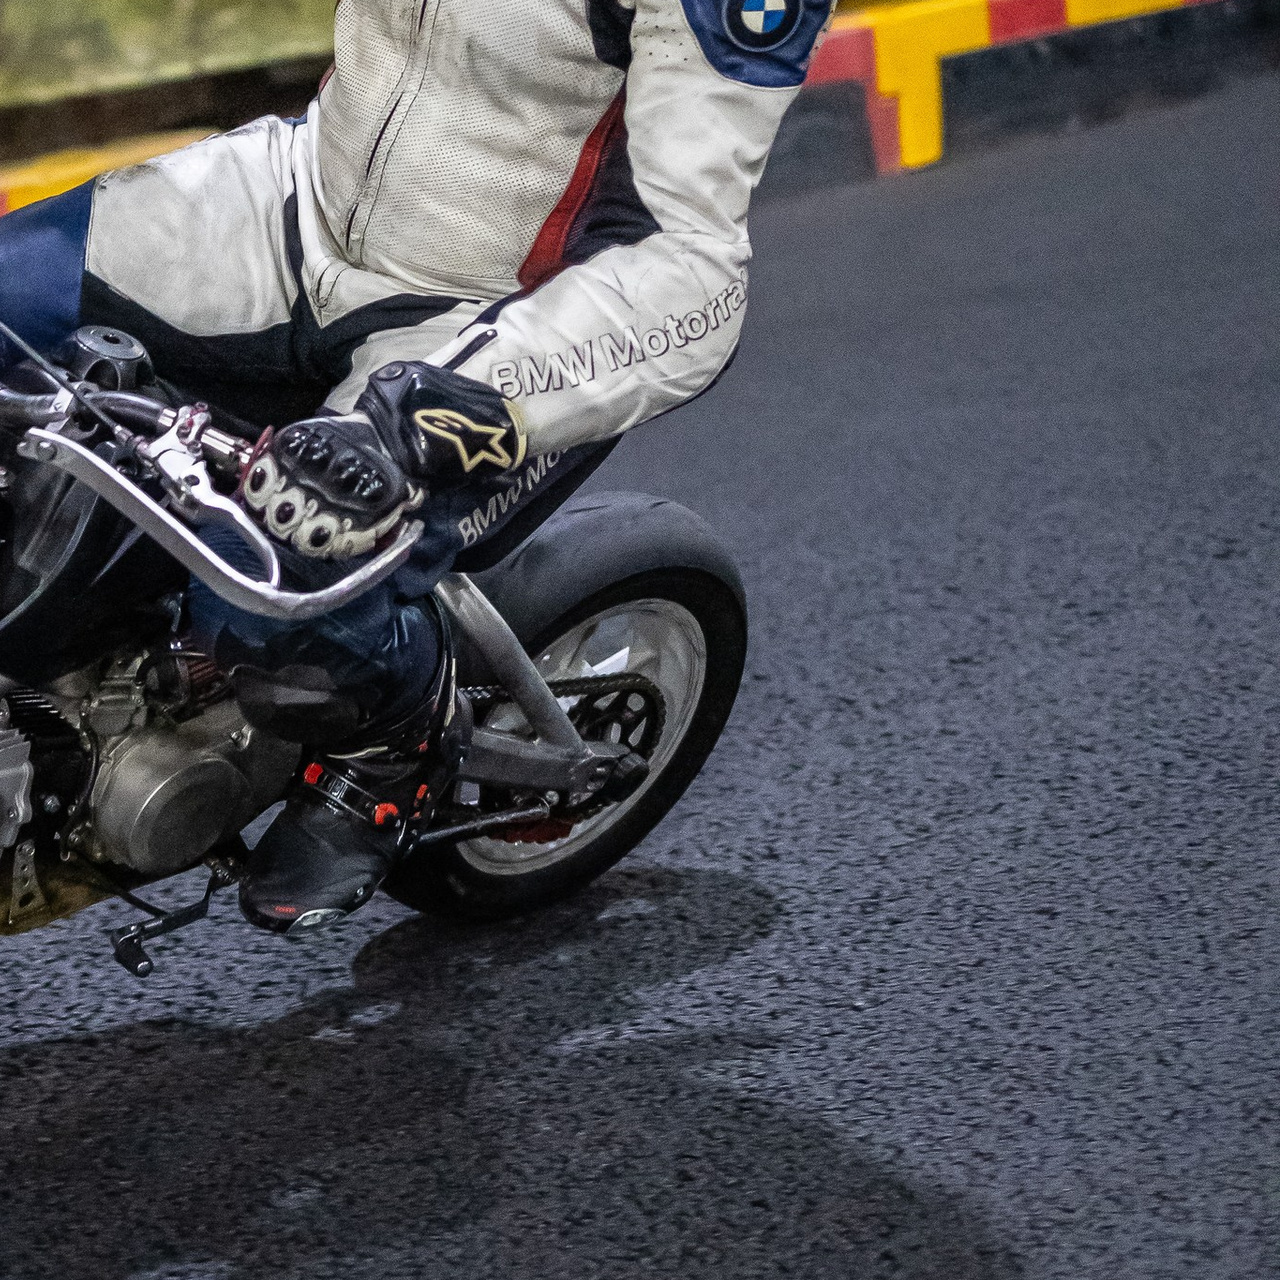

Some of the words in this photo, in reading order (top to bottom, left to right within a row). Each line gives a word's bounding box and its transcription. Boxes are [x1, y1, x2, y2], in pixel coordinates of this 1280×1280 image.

[490, 339, 596, 401] BMW
[598, 269, 748, 373] Motorra
[458, 476, 523, 548] BMW
